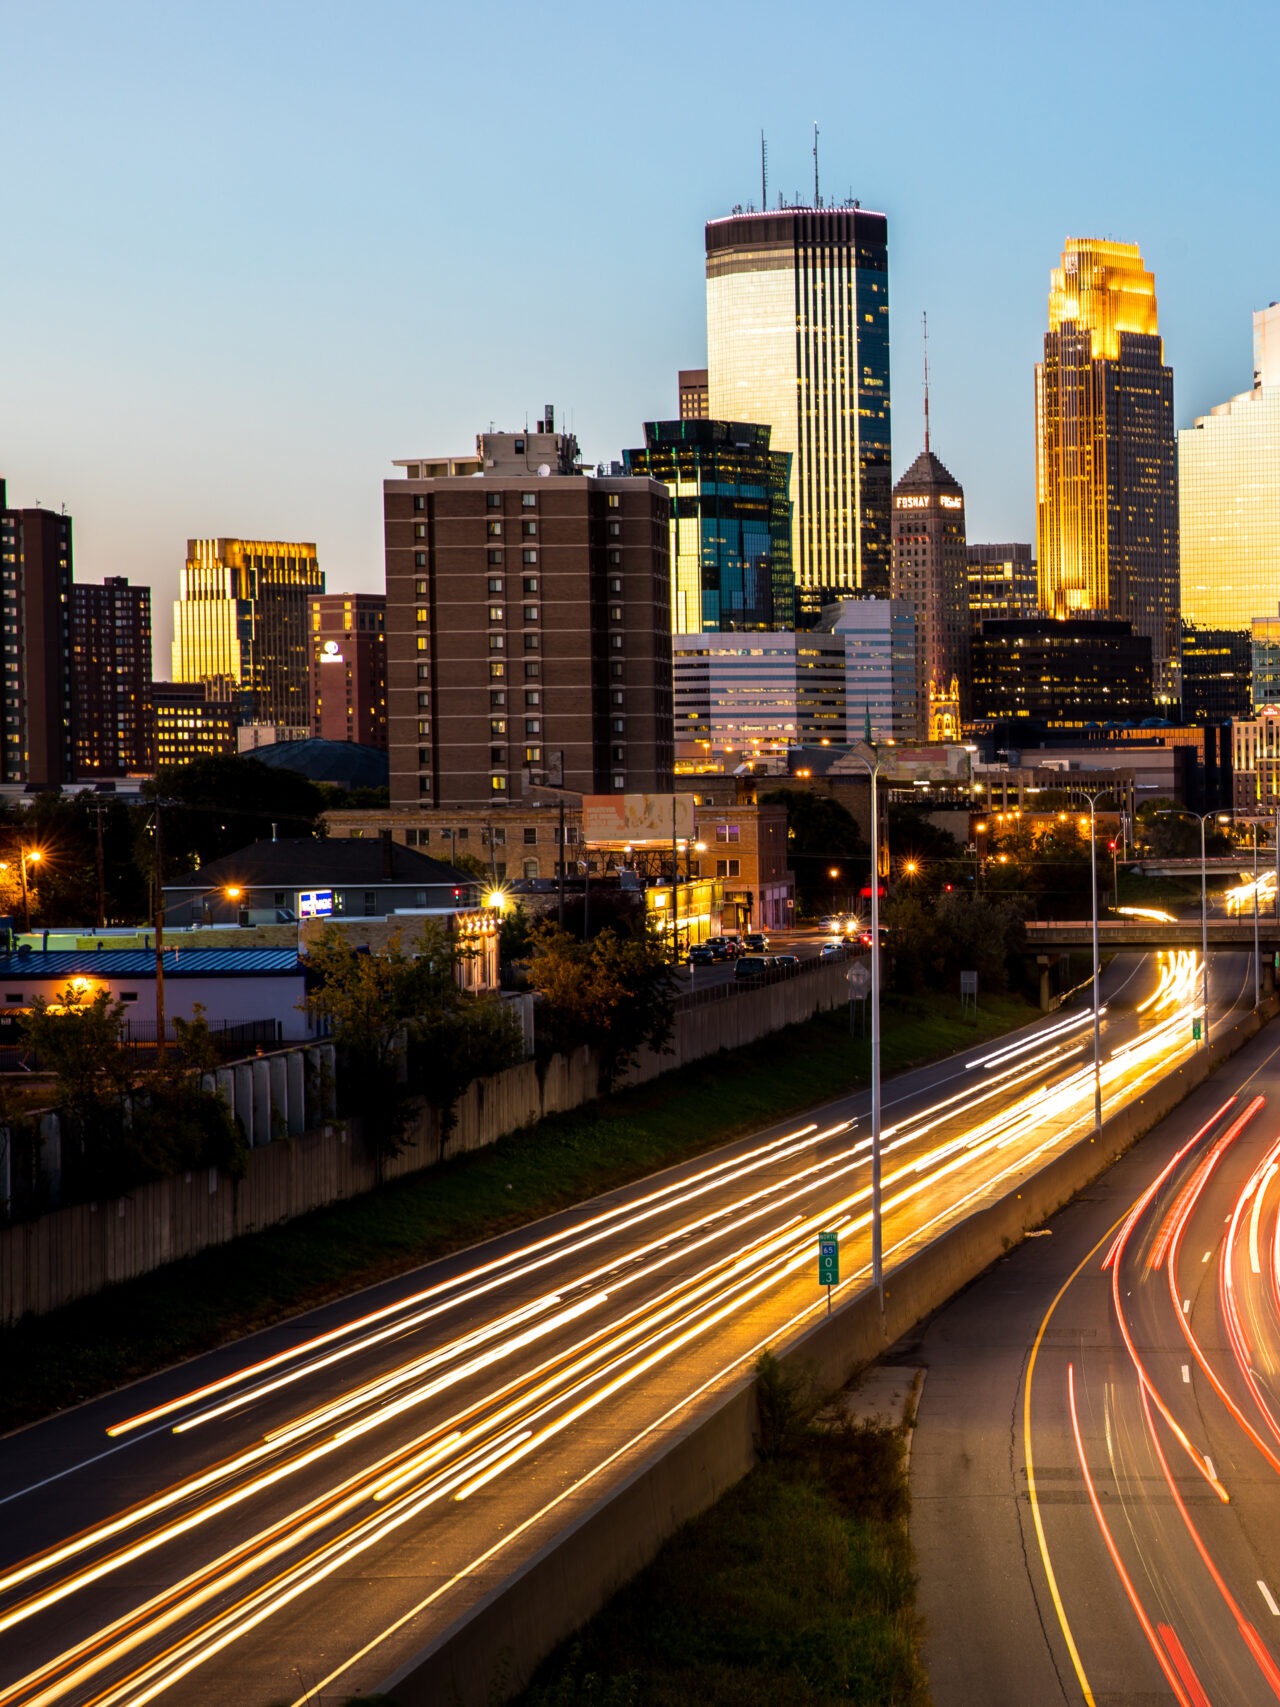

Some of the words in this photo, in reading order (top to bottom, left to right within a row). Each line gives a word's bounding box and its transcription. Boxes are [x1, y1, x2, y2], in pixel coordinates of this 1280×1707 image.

[896, 496, 930, 509] FOSHAY
[823, 1246, 834, 1254] 65
[825, 1257, 833, 1268] 0
